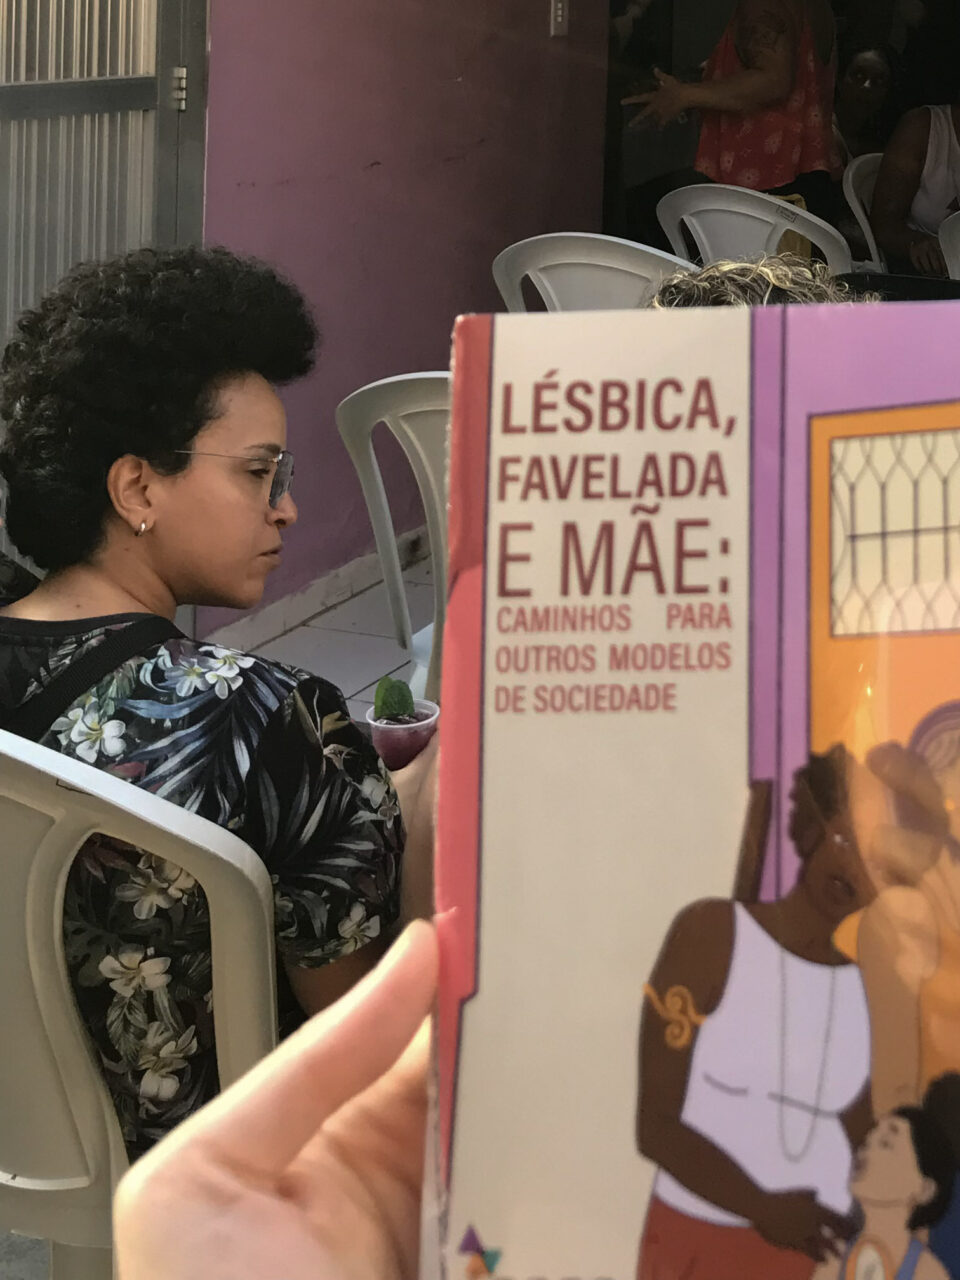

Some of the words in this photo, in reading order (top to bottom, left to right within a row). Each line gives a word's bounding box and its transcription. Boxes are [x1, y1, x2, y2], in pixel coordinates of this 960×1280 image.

[502, 369, 737, 438] LÉSBICA,
[497, 452, 729, 502] FAVELADA
[497, 521, 533, 598] E
[560, 502, 730, 597] MÃE:
[496, 604, 632, 633] CAMINHOS
[666, 602, 731, 631] PARA
[496, 644, 597, 674] OUTROS
[609, 642, 731, 672] MODELOS
[495, 685, 526, 714] DE
[533, 683, 677, 714] SOCIEDADE
